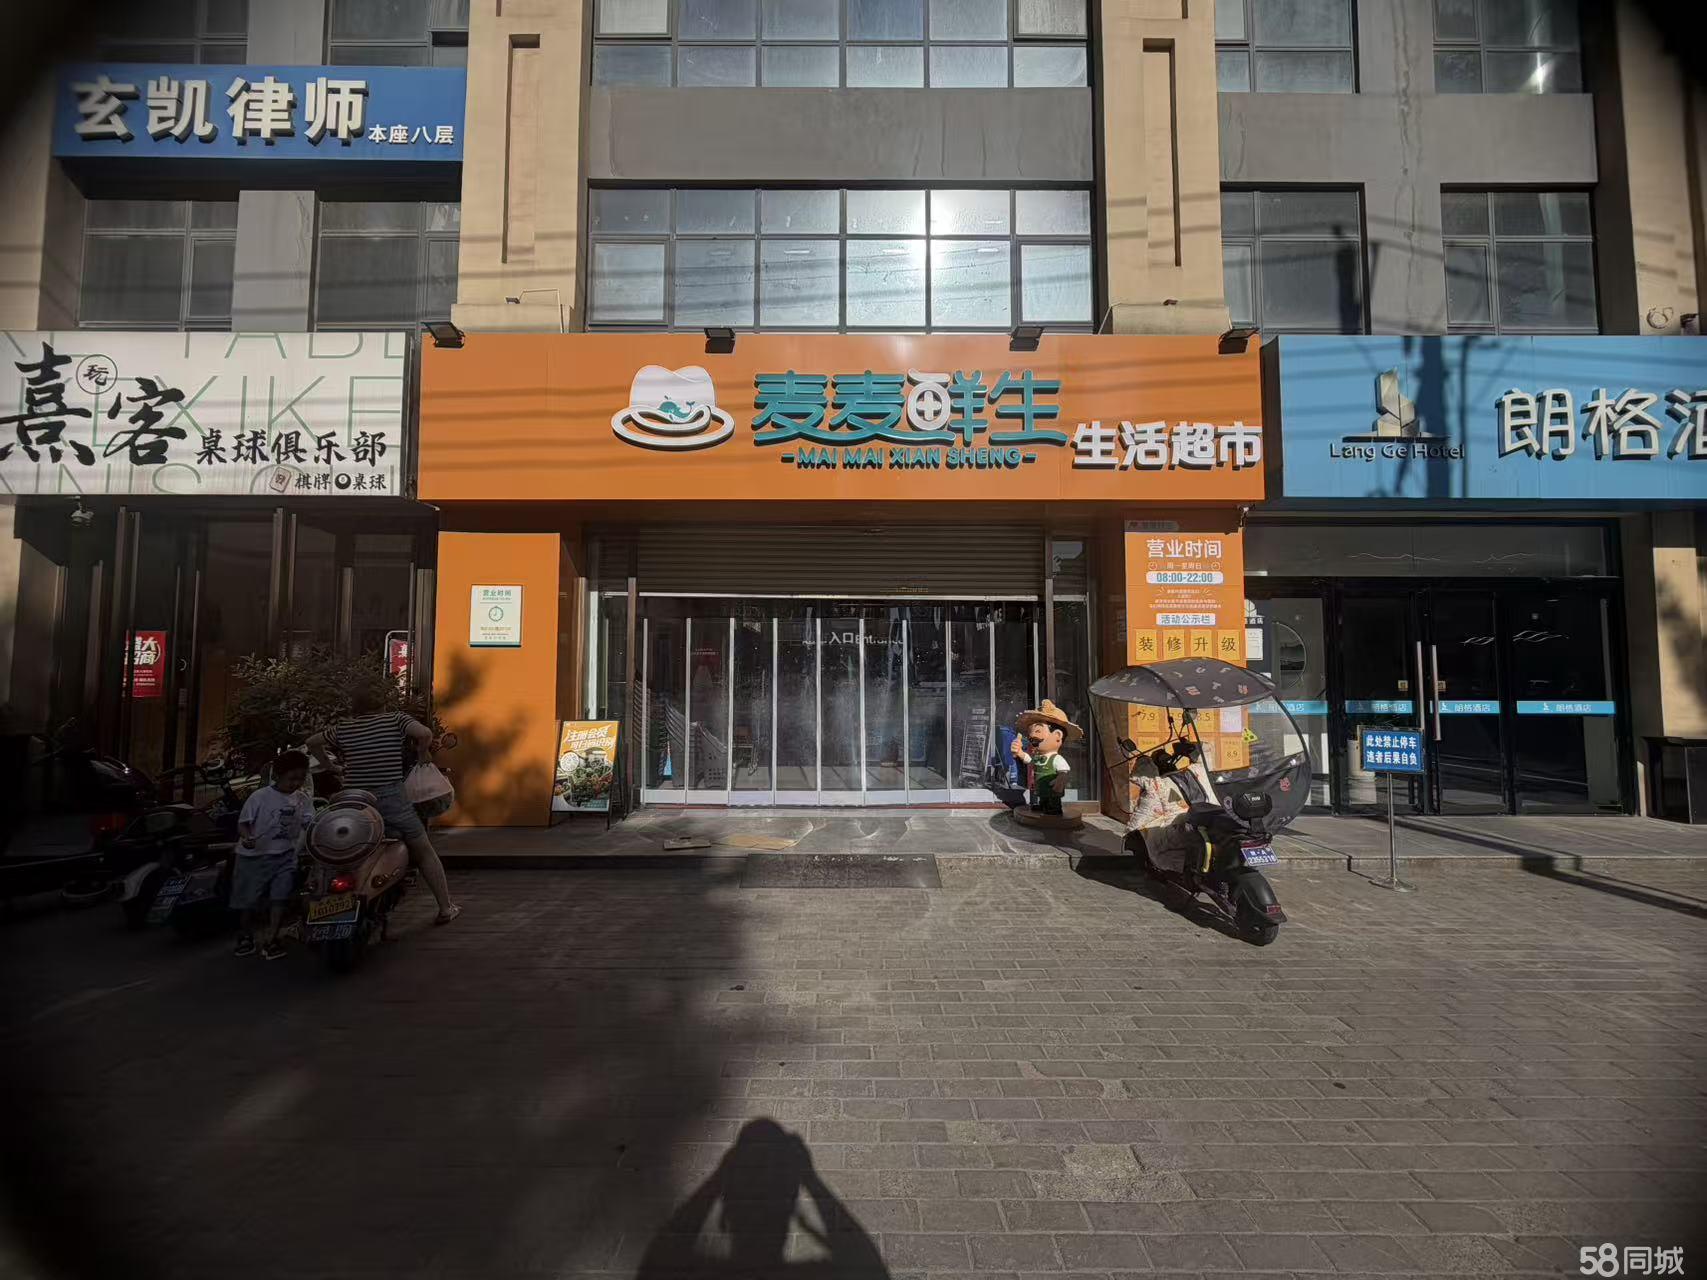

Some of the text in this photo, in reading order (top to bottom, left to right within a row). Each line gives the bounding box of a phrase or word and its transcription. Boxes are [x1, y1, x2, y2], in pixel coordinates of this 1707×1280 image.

[72, 75, 368, 143] 玄凯律师
[368, 124, 455, 145] 本座八层
[82, 364, 109, 387] 玩
[753, 368, 1069, 446] 麦麦鲜生
[195, 428, 386, 466] 桌球俱乐部
[1072, 420, 1262, 470] 生活超市
[1330, 442, 1464, 462] Lang Ge Hotel
[799, 446, 1021, 470] MAI MAI XIAN SHENG
[294, 472, 331, 490] 棋牌
[352, 472, 387, 491] 桌球
[1146, 539, 1222, 559] 营业时间
[1156, 573, 1214, 583] 08:00-22:00
[1160, 614, 1210, 625] 活动公示栏
[829, 631, 854, 644] 入口
[1138, 636, 1237, 652] 装修升级
[1366, 734, 1417, 749] 此处禁止停车
[1366, 750, 1418, 765] 违者后果自负
